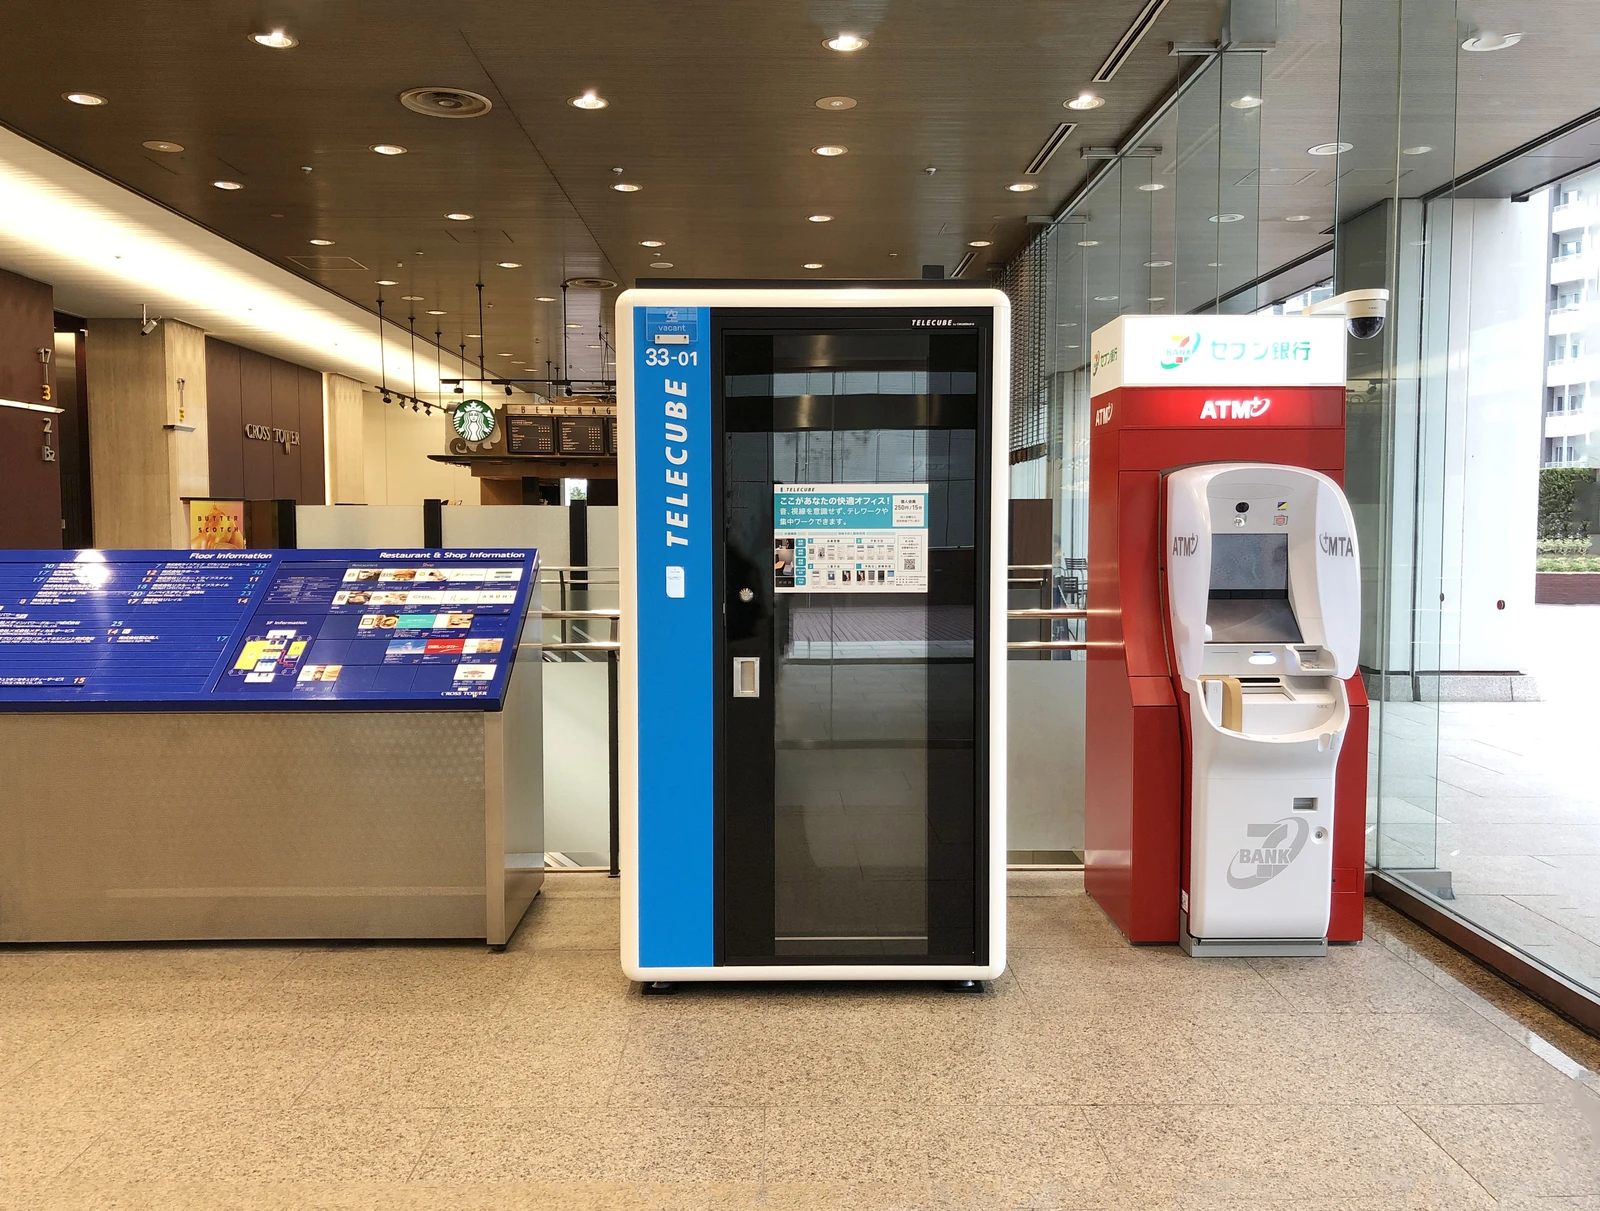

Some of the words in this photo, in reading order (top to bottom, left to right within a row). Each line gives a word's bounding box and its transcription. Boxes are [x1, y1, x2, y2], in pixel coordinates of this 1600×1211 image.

[646, 348, 698, 366] 33-01
[1211, 340, 1311, 361] セブン銀行
[42, 384, 51, 400] 3
[43, 418, 52, 432] 2
[246, 423, 270, 440] CROSS
[272, 428, 300, 454] TOWER
[664, 378, 688, 547] TELECUBE
[780, 497, 890, 505] ここがあなたの快適オフィス！
[780, 508, 888, 516] 音、視線を意識せず、テレワークや
[444, 552, 467, 560] Shop
[1240, 848, 1290, 864] BANK
